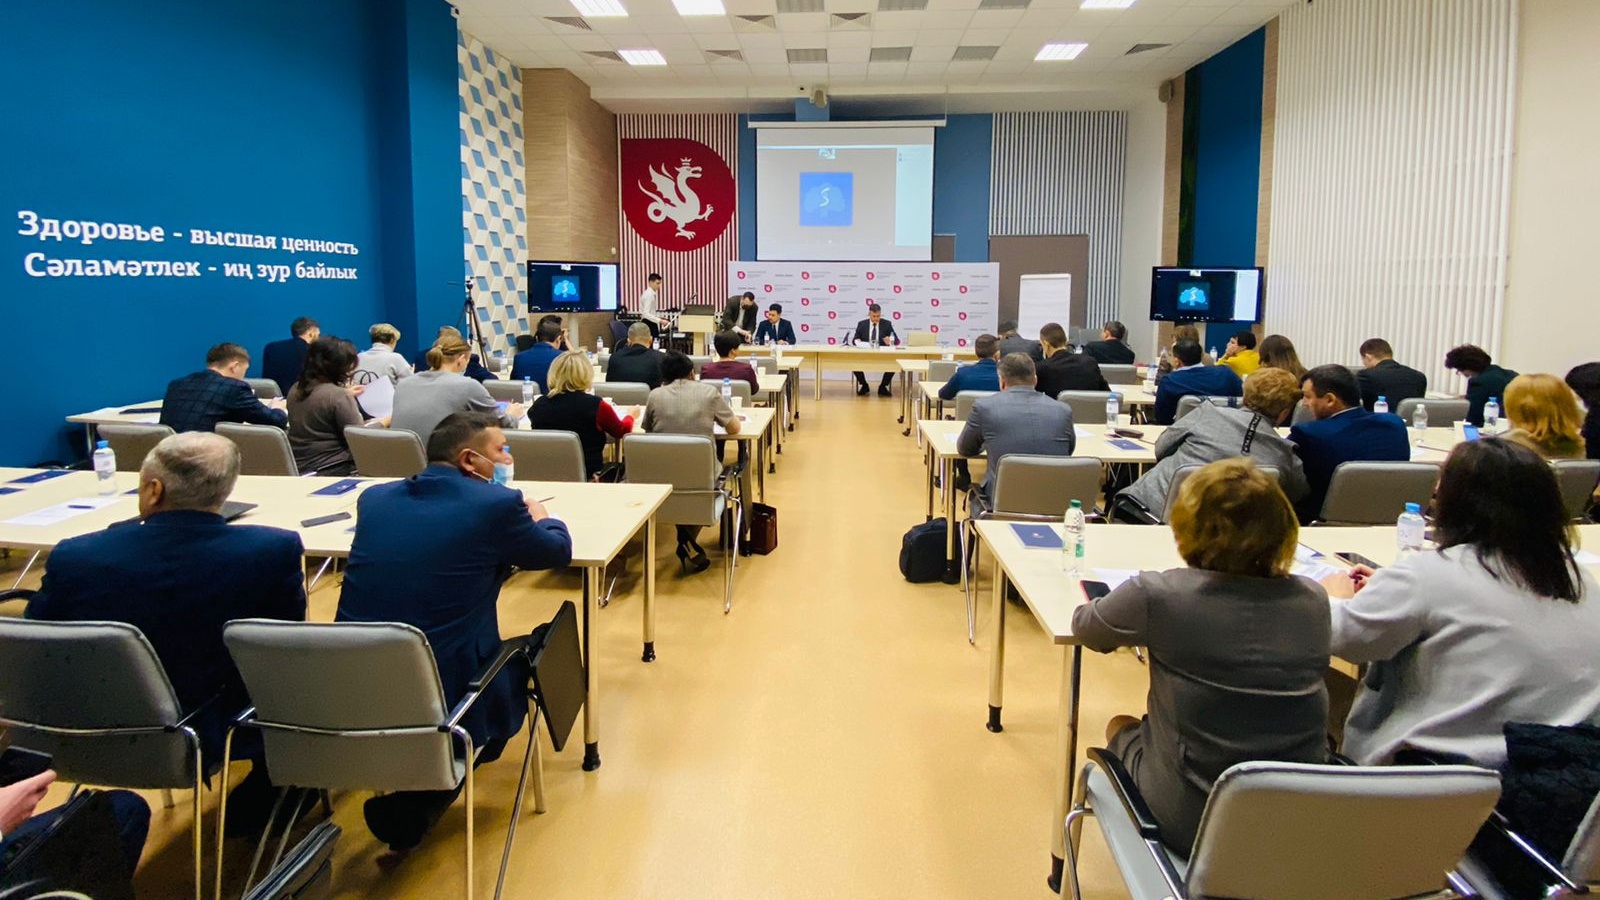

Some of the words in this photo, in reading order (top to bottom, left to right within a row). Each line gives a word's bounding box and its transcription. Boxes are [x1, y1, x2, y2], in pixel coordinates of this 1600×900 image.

[17, 210, 165, 245] Здоровье
[190, 229, 277, 250] высшая
[282, 236, 359, 255] ценность
[24, 252, 201, 277] Сәламәтлек
[223, 262, 254, 280] иң
[256, 264, 291, 283] зур
[295, 260, 358, 280] байлык
